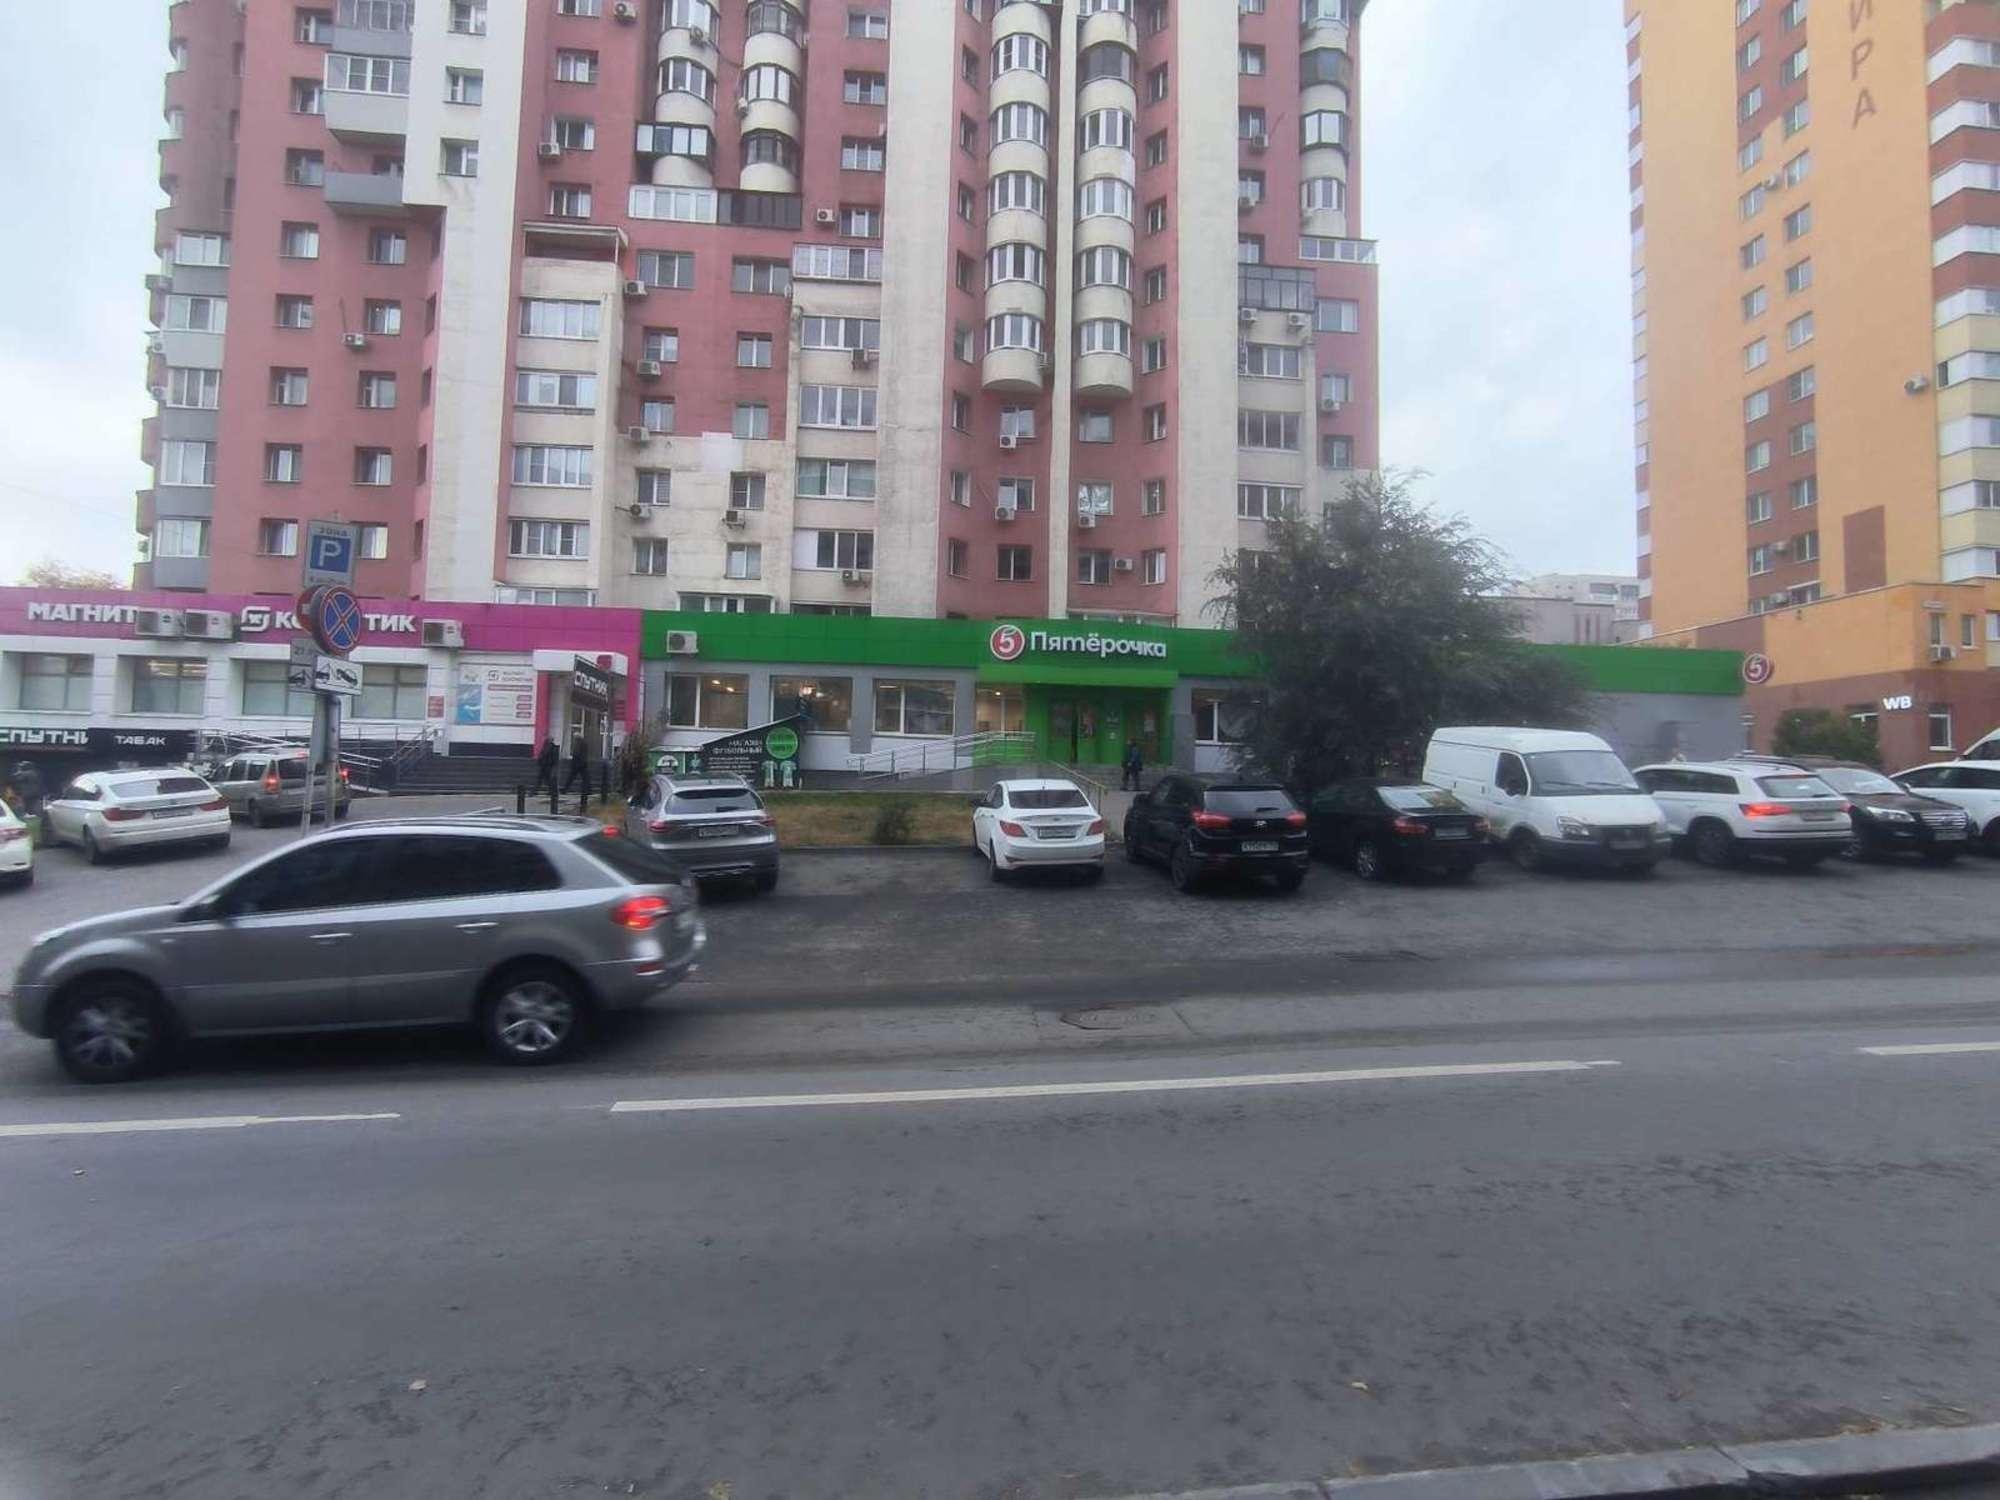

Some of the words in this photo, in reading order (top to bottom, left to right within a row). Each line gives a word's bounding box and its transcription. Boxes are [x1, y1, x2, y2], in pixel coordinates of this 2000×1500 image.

[28, 602, 139, 624] МАГНИТ
[1030, 631, 1168, 658] Пятёрочка
[1883, 695, 1913, 711] WB
[114, 735, 167, 746] ТАБАК
